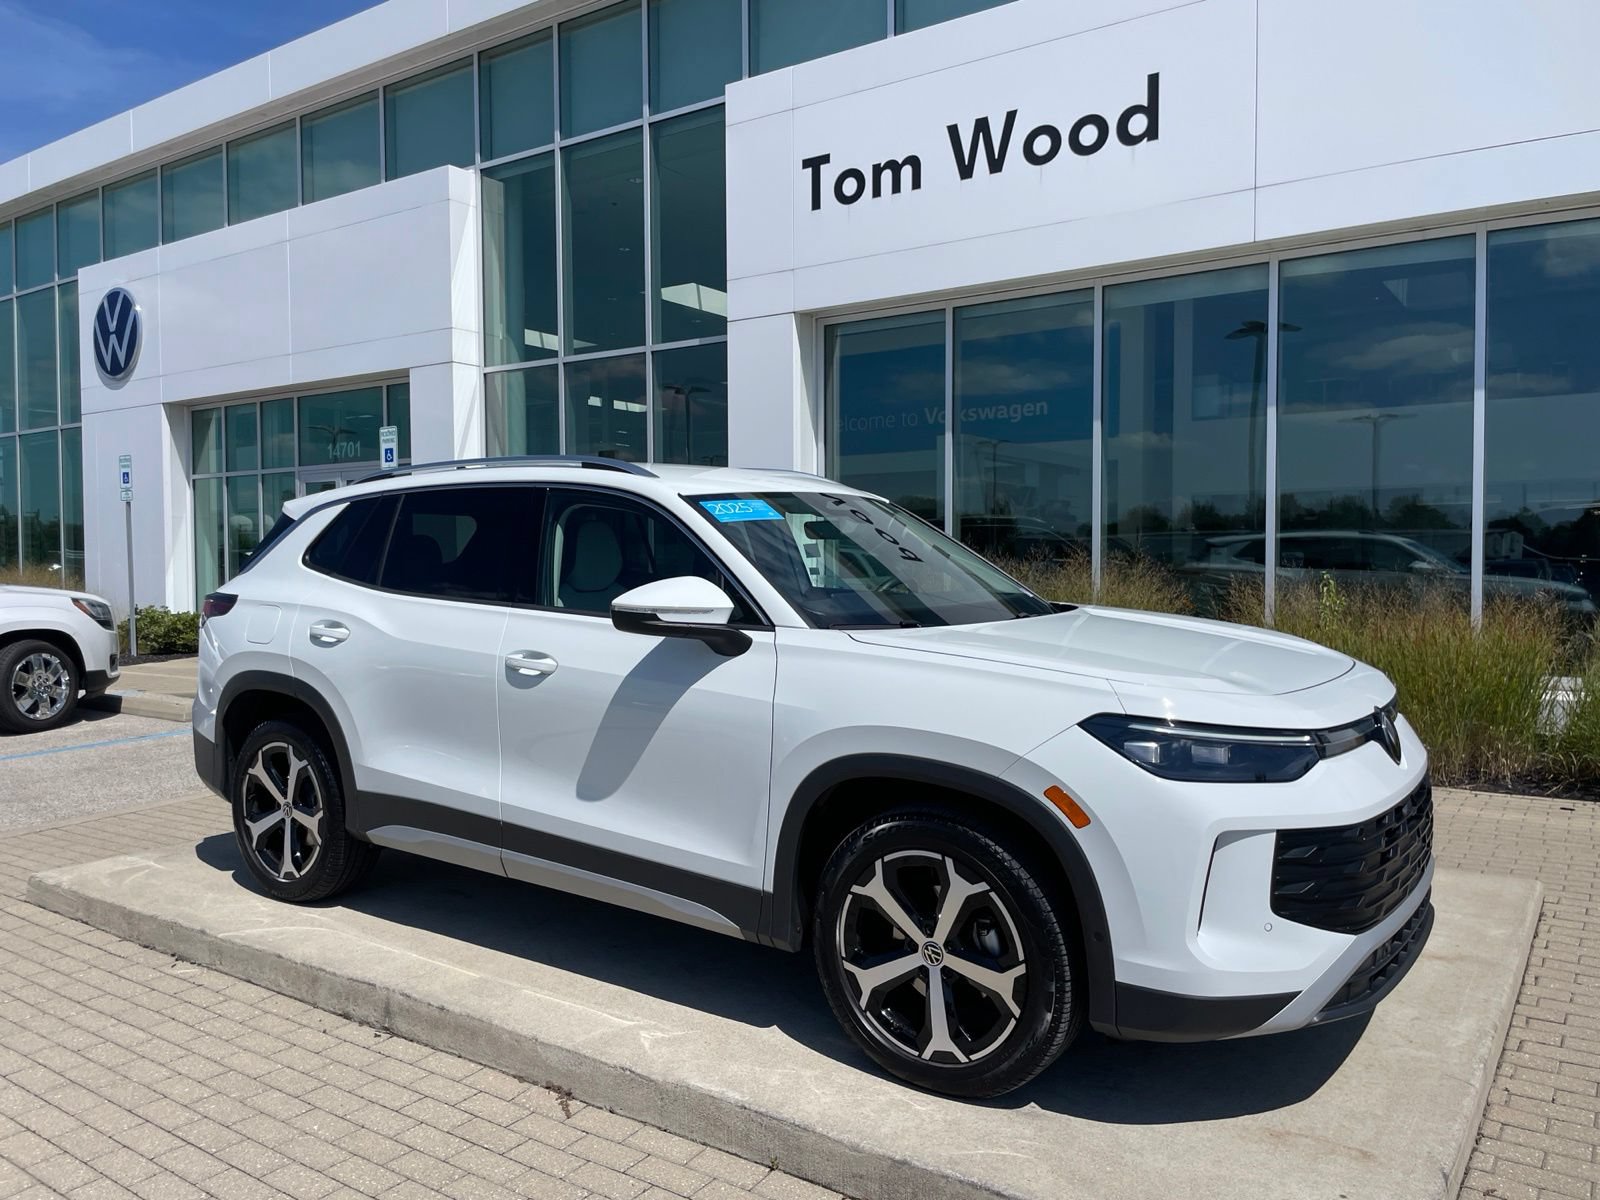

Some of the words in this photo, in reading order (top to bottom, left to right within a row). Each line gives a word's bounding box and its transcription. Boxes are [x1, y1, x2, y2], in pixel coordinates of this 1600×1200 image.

[802, 153, 921, 211] Tom
[946, 72, 1160, 181] Wood
[94, 288, 140, 376] VW
[836, 413, 897, 433] elcome
[902, 411, 919, 427] to
[924, 401, 1048, 425] Vokswagen
[327, 441, 361, 459] 14701
[707, 502, 753, 515] 2025
